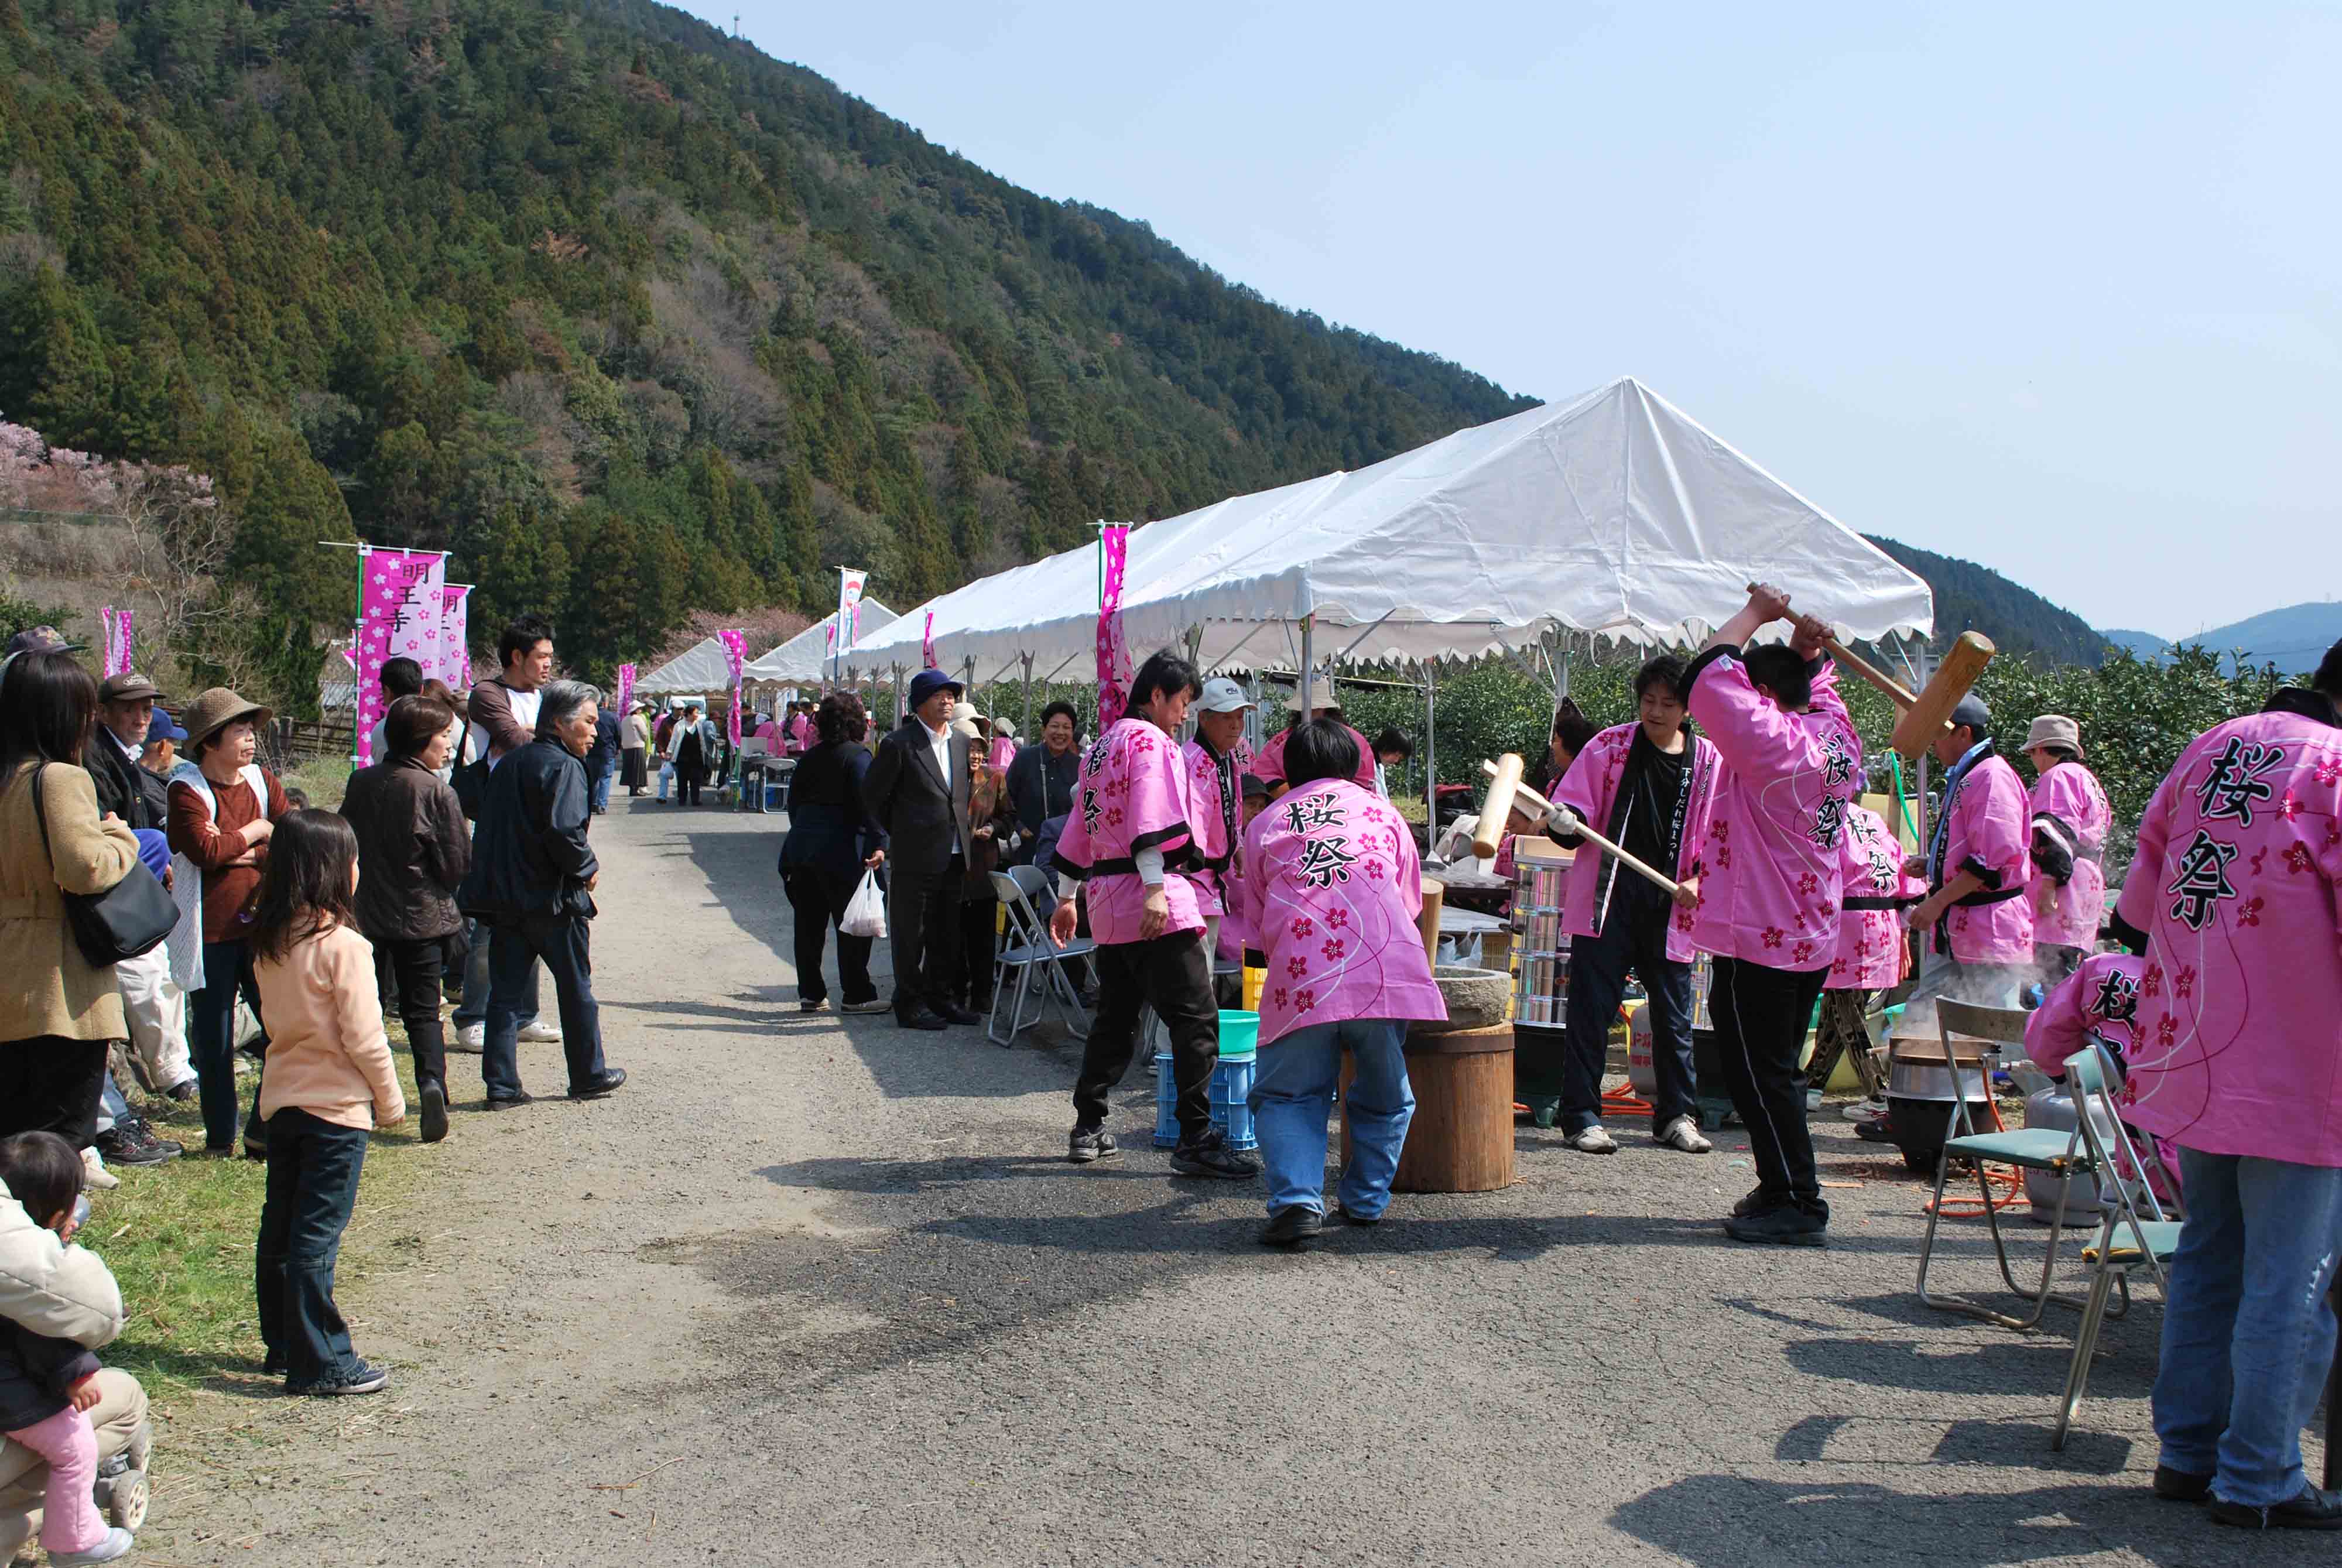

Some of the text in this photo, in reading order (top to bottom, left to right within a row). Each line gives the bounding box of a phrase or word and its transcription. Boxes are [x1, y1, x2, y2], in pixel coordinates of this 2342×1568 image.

[1669, 767, 1693, 861] 下分しだれ桜まつり
[1807, 732, 1853, 850] 桜祭
[2167, 735, 2285, 931] 桜祭
[1283, 793, 1359, 889] 桜祭
[1846, 813, 1898, 891] 桜祭
